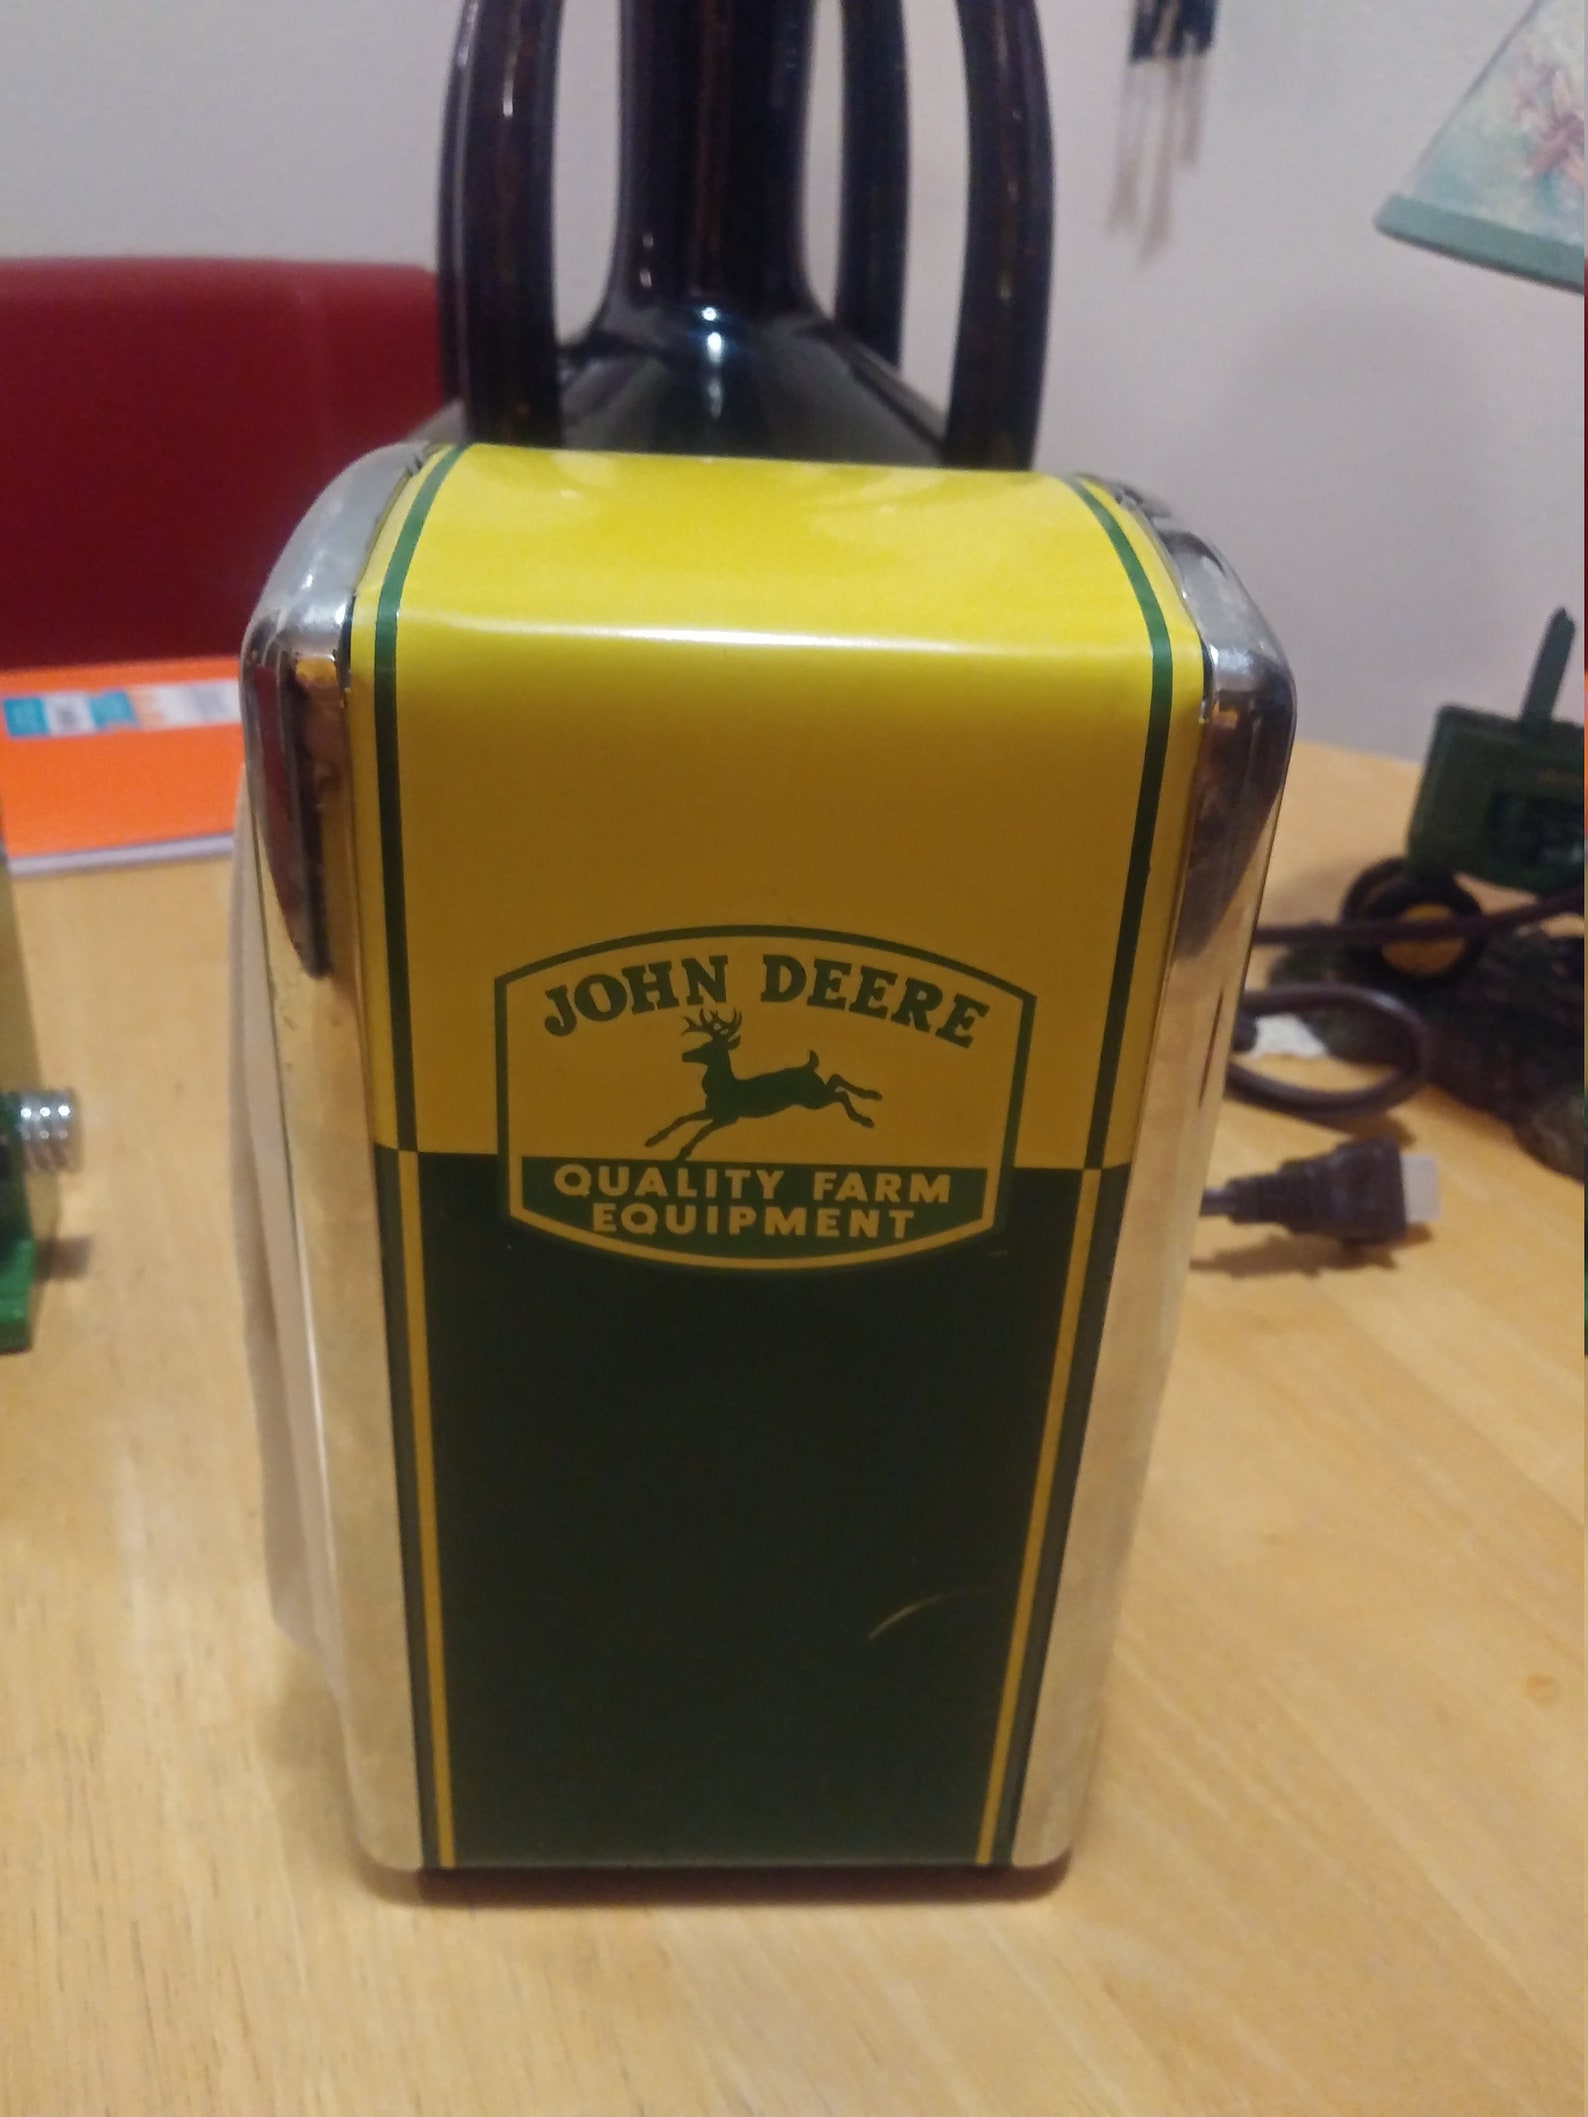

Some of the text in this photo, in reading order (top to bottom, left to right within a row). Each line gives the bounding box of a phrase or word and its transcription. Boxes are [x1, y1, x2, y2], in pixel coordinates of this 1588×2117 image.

[544, 954, 991, 1049] JOHN DEERE
[553, 1163, 952, 1204] QUALITY FARM
[592, 1202, 914, 1238] EQUIPMENT
